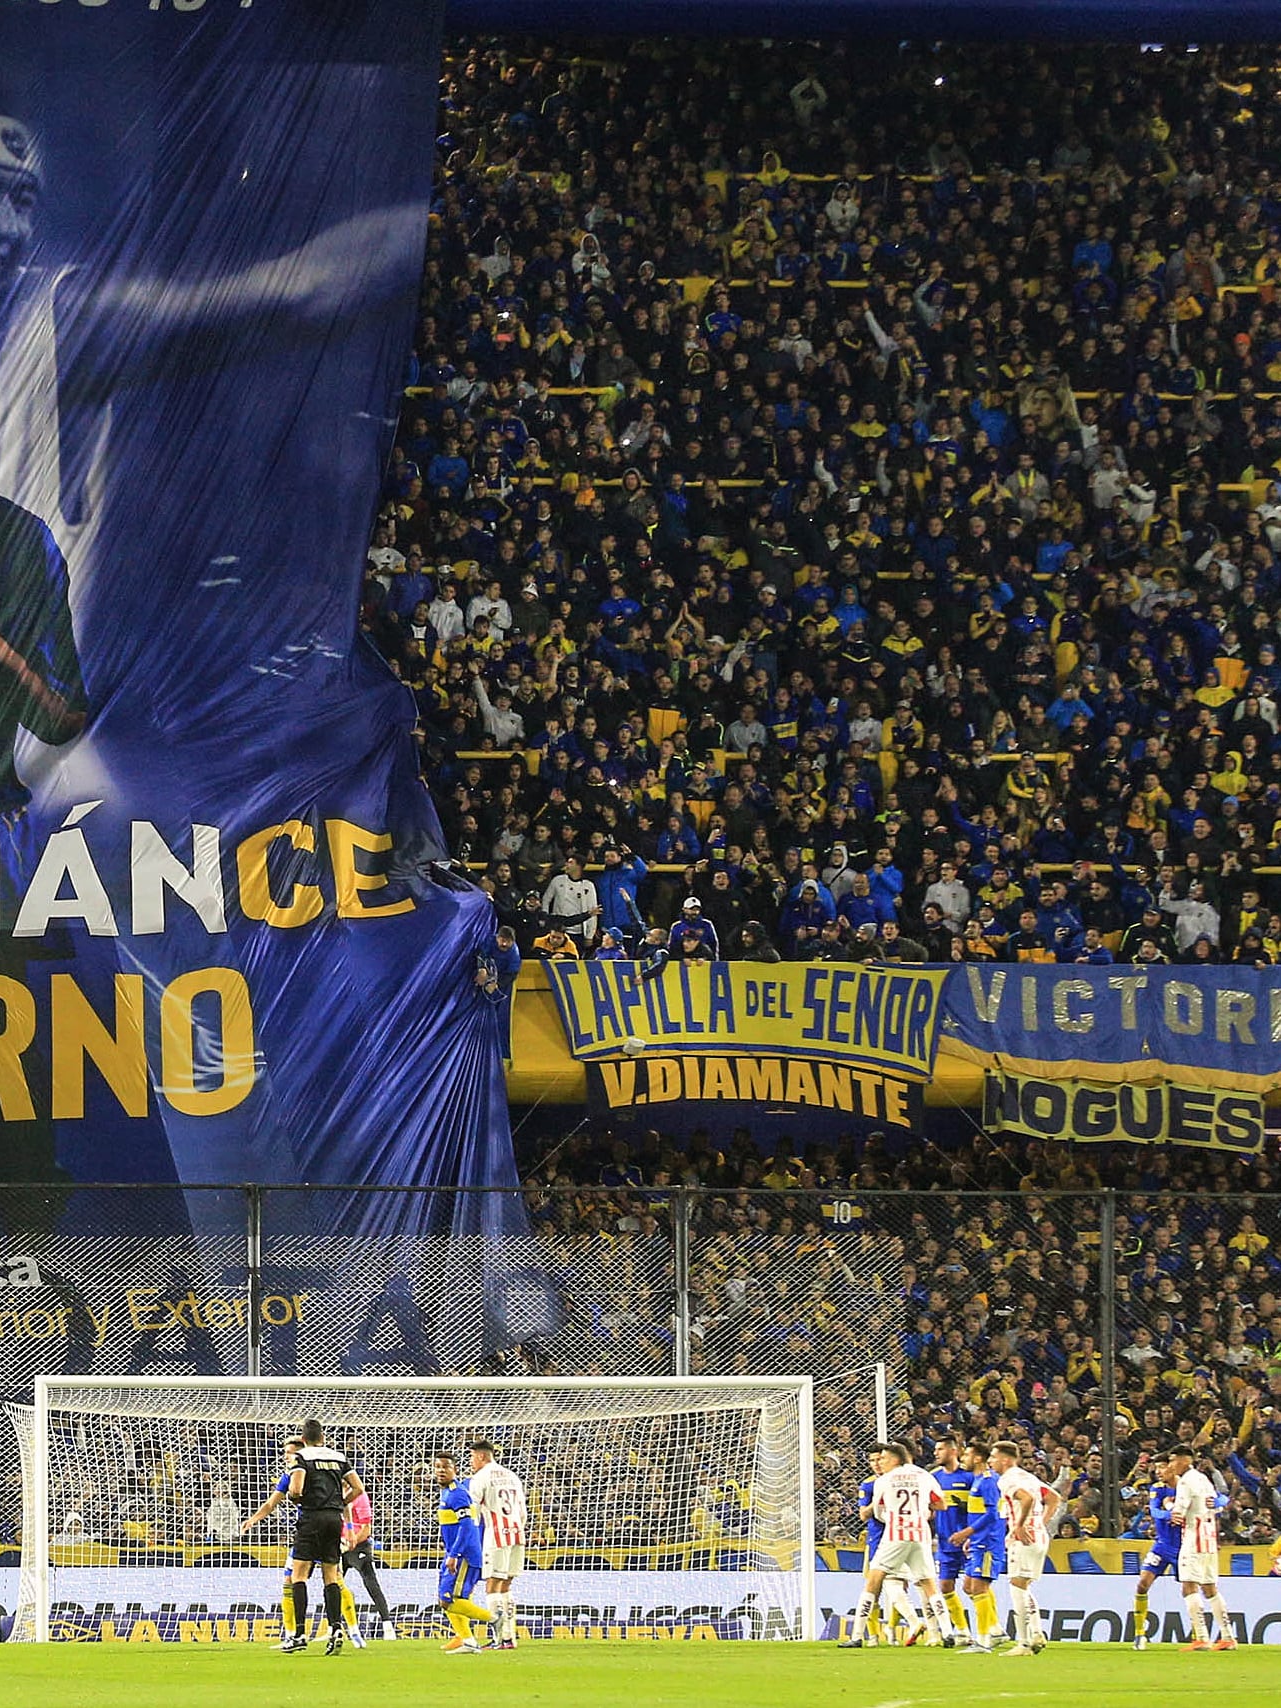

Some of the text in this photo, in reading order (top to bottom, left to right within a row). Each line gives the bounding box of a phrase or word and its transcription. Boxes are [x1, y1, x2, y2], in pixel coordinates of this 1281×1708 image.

[556, 962, 933, 1063] CAPILLA DEL SEÑOR
[600, 1056, 911, 1129] V.DIAMANTE
[984, 1074, 1262, 1148] NOGUES
[833, 1201, 851, 1223] 10
[86, 1302, 111, 1347] y
[499, 1488, 517, 1516] 37
[897, 1489, 920, 1516] 21
[101, 1620, 162, 1642] LA
